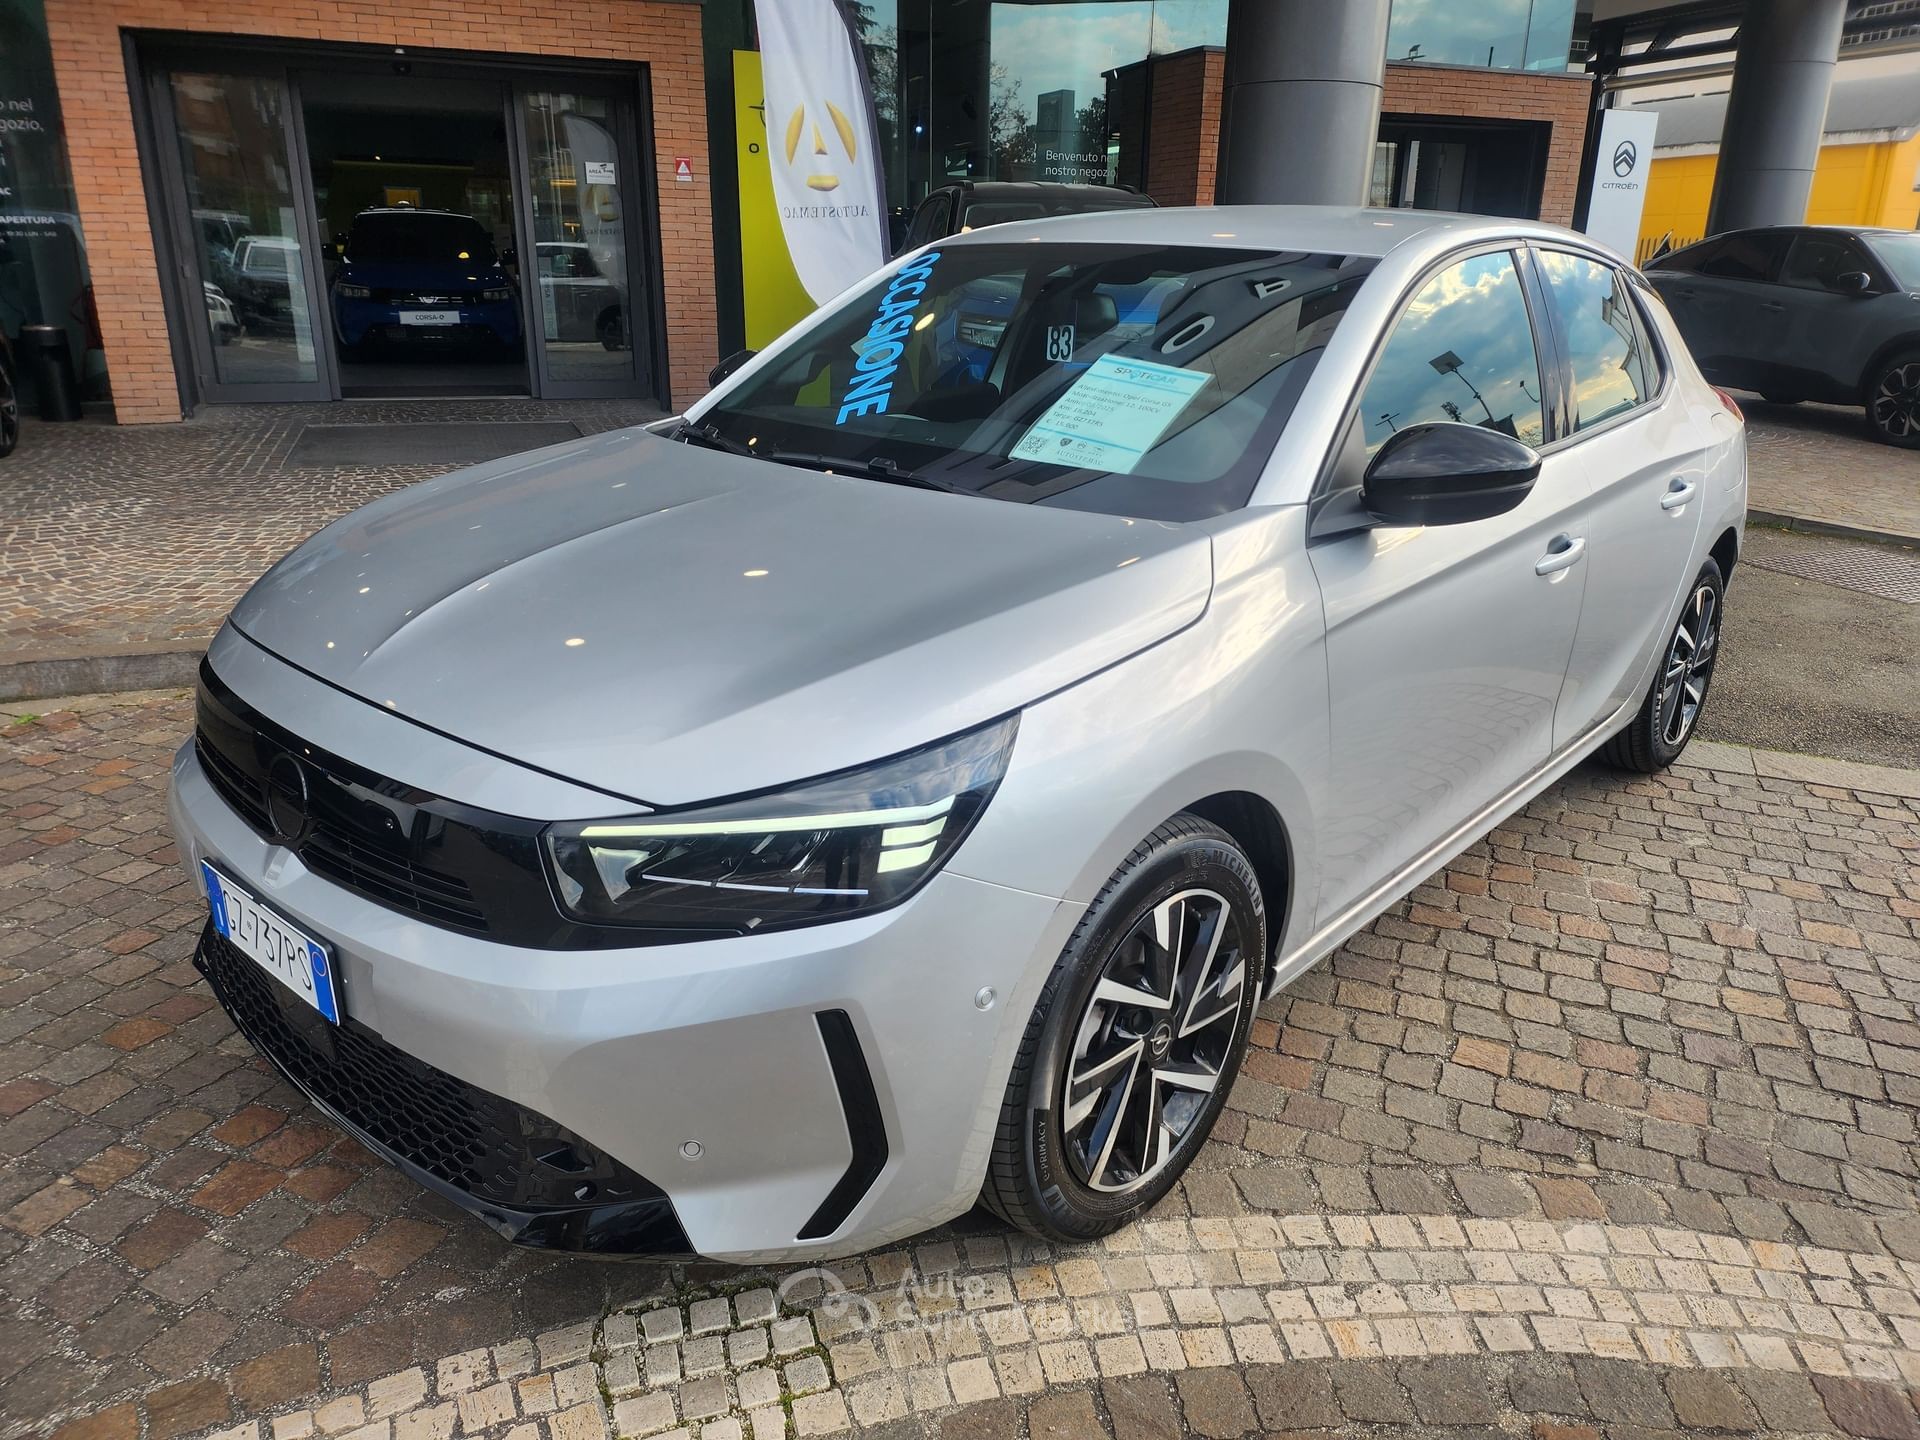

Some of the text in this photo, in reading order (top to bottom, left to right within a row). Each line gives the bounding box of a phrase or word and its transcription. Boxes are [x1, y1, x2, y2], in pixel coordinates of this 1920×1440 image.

[8, 98, 33, 111] nel
[1045, 149, 1098, 162] Benvenuto
[1045, 166, 1077, 177] nostro
[835, 252, 942, 426] OCCASIONE
[1049, 325, 1073, 361] 83
[1212, 849, 1263, 912] MICHELIN
